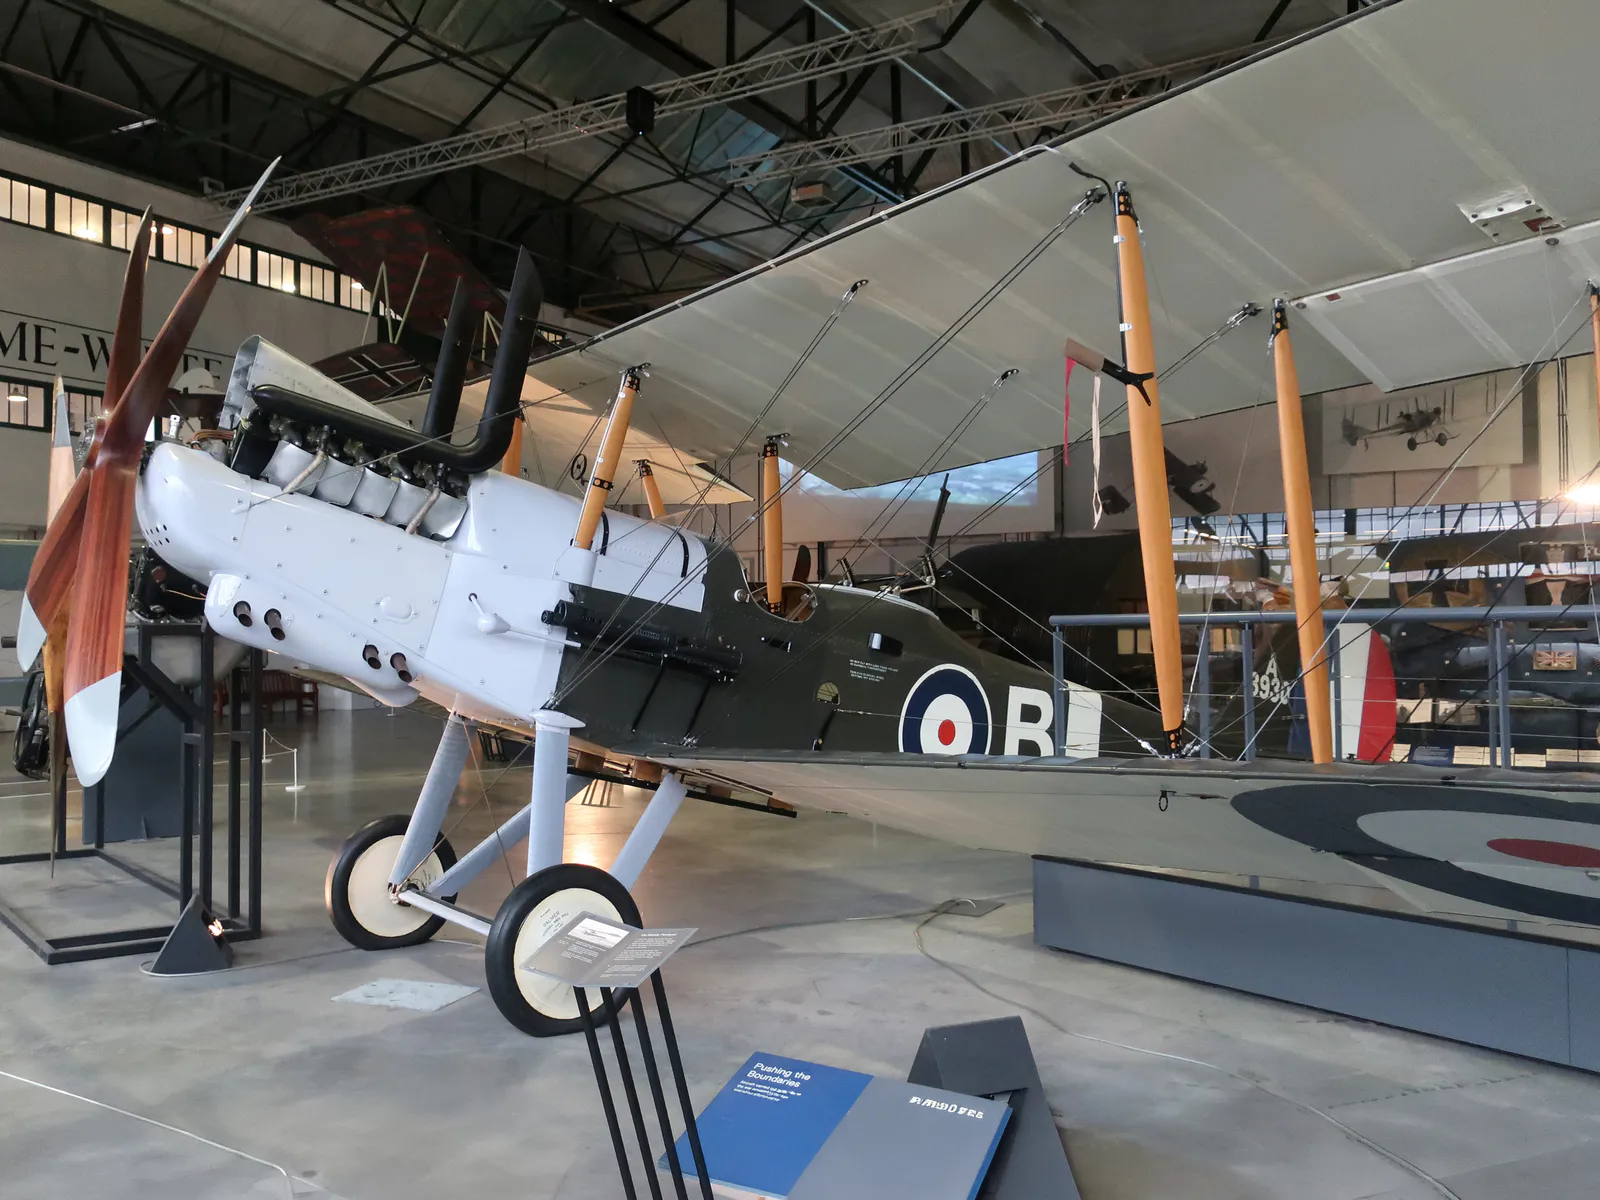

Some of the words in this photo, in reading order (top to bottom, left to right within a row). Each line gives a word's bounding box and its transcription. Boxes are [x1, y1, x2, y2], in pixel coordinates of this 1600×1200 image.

[1265, 653, 1278, 678] A
[747, 1070, 801, 1087] Boundaries
[754, 1062, 793, 1078] Pushing
[794, 1071, 812, 1081] the
